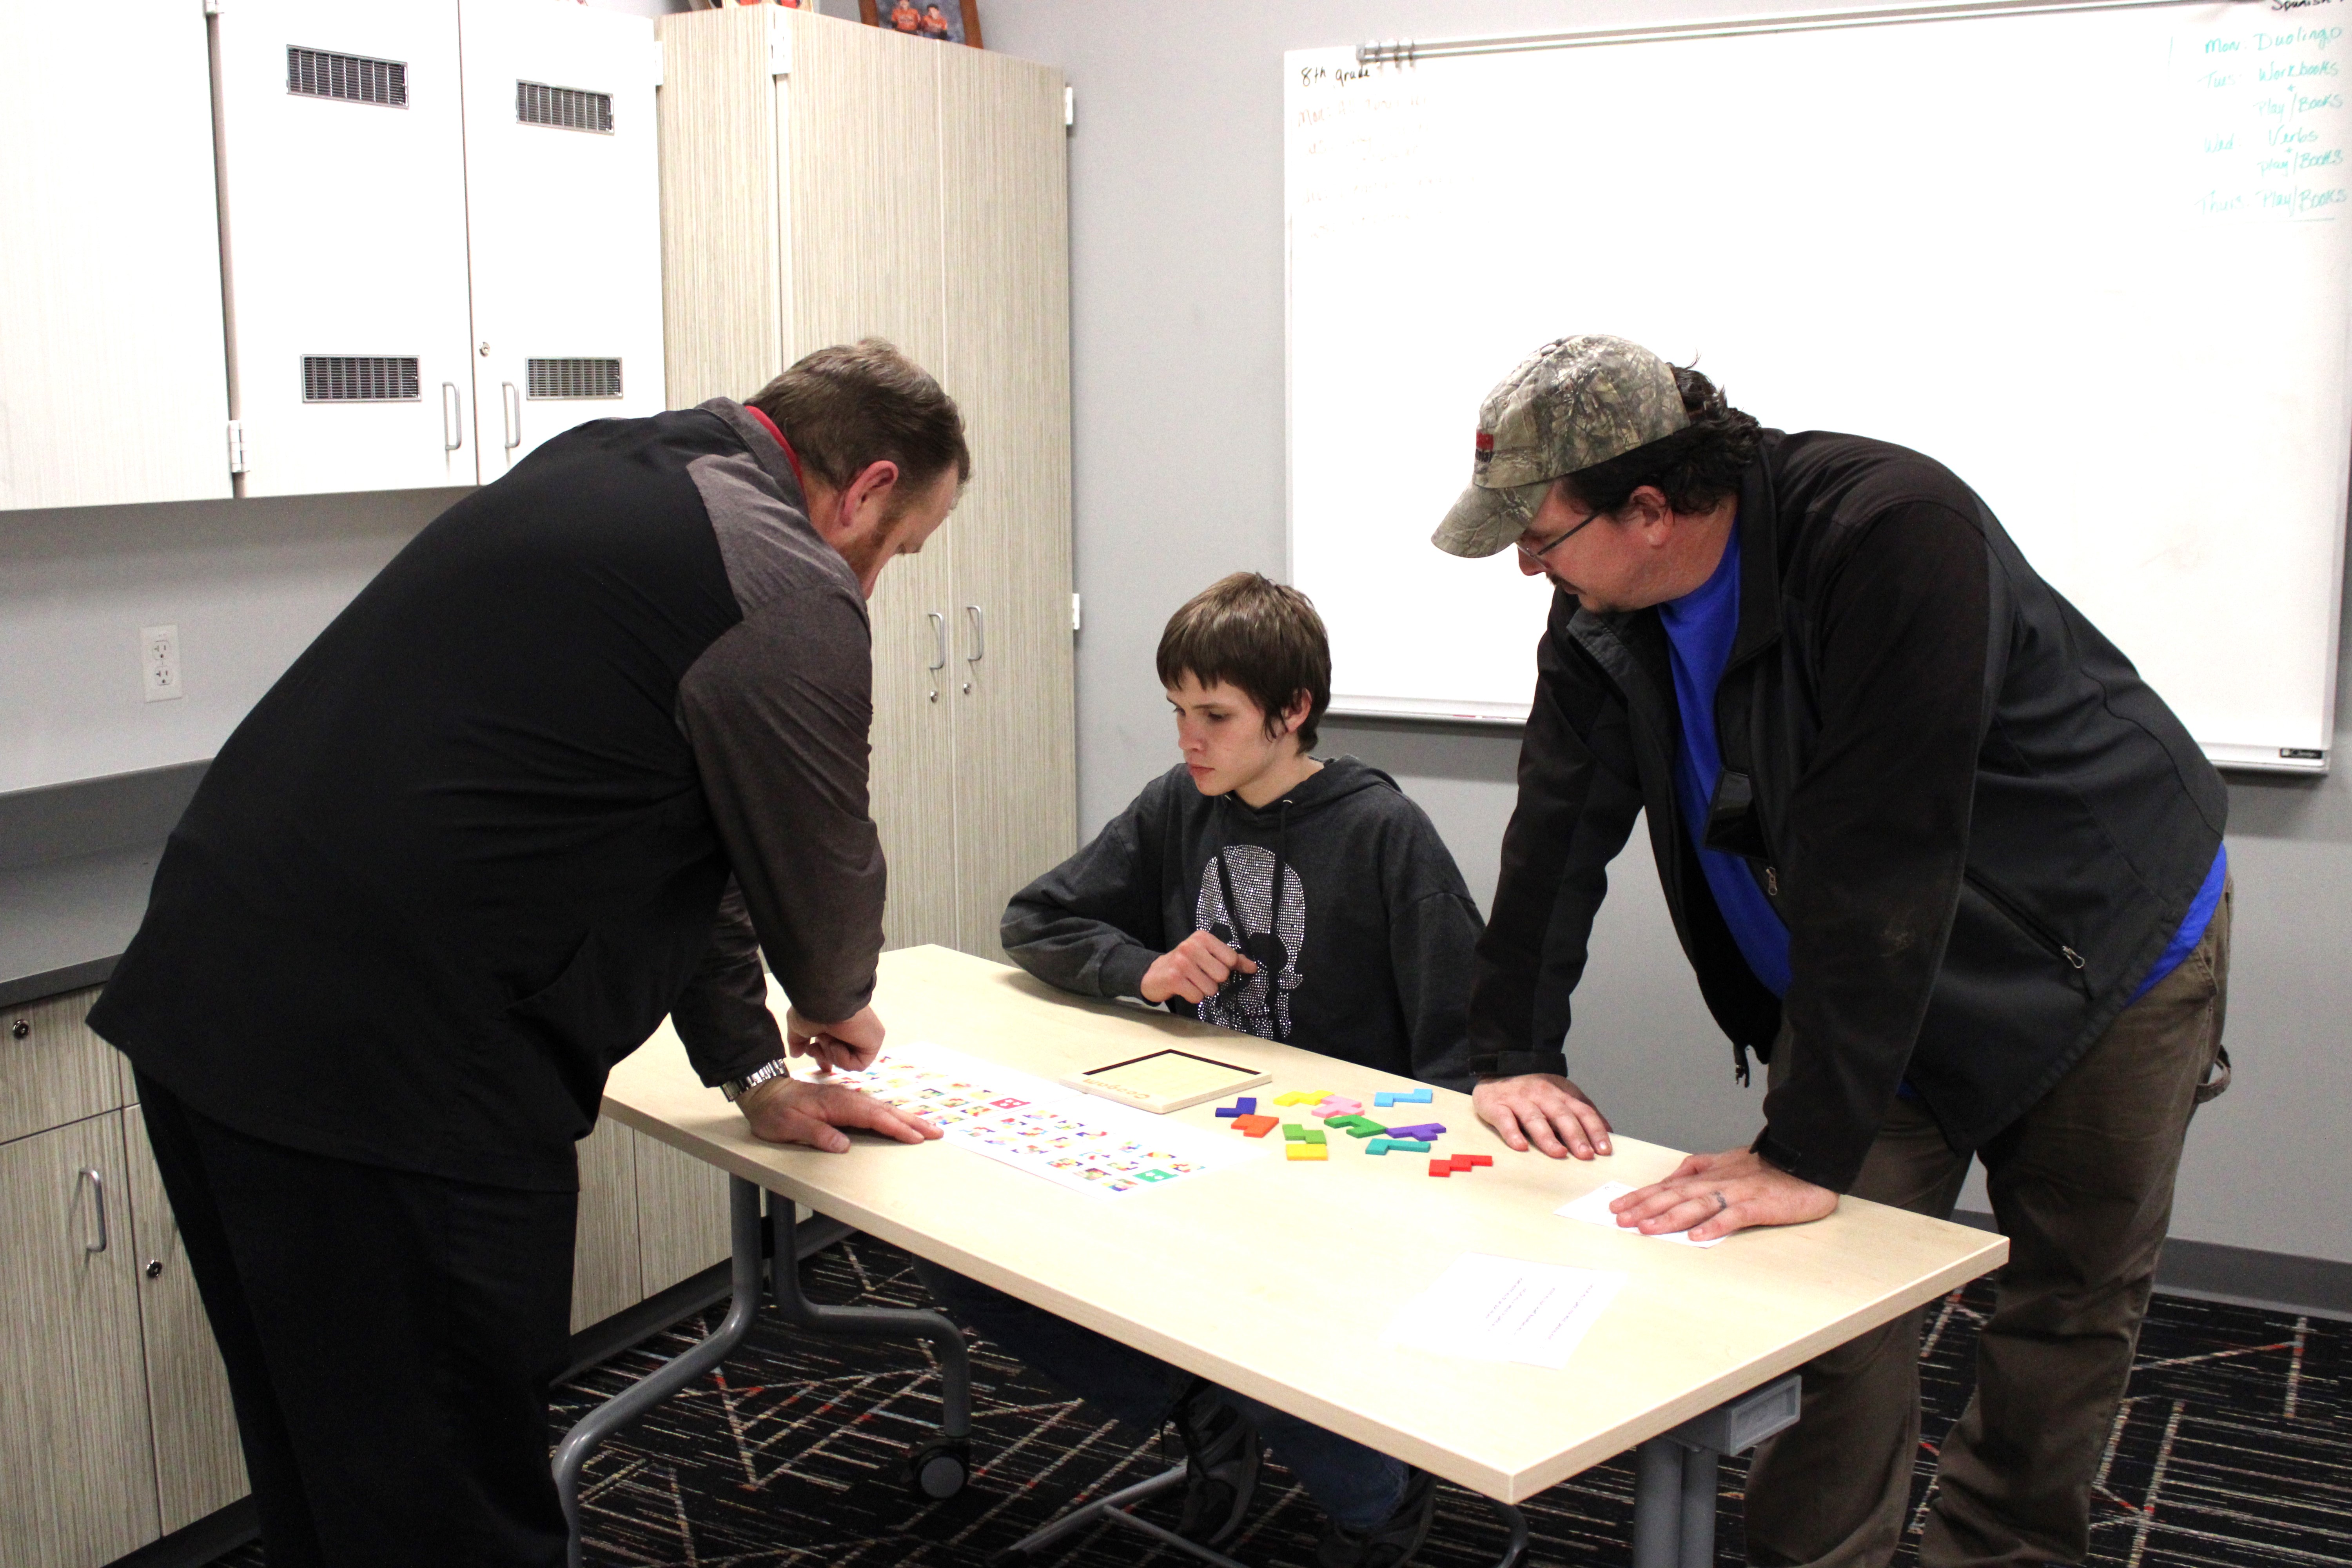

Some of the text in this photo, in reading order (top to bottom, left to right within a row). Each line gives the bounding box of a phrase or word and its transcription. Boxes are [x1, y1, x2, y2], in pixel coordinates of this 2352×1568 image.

[2253, 26, 2343, 50] Duolingo
[1301, 66, 1370, 87] 8th grade
[2259, 60, 2339, 81] Workbooks
[2269, 124, 2319, 147] Verbs
[1083, 1079, 1150, 1099] Coogam
